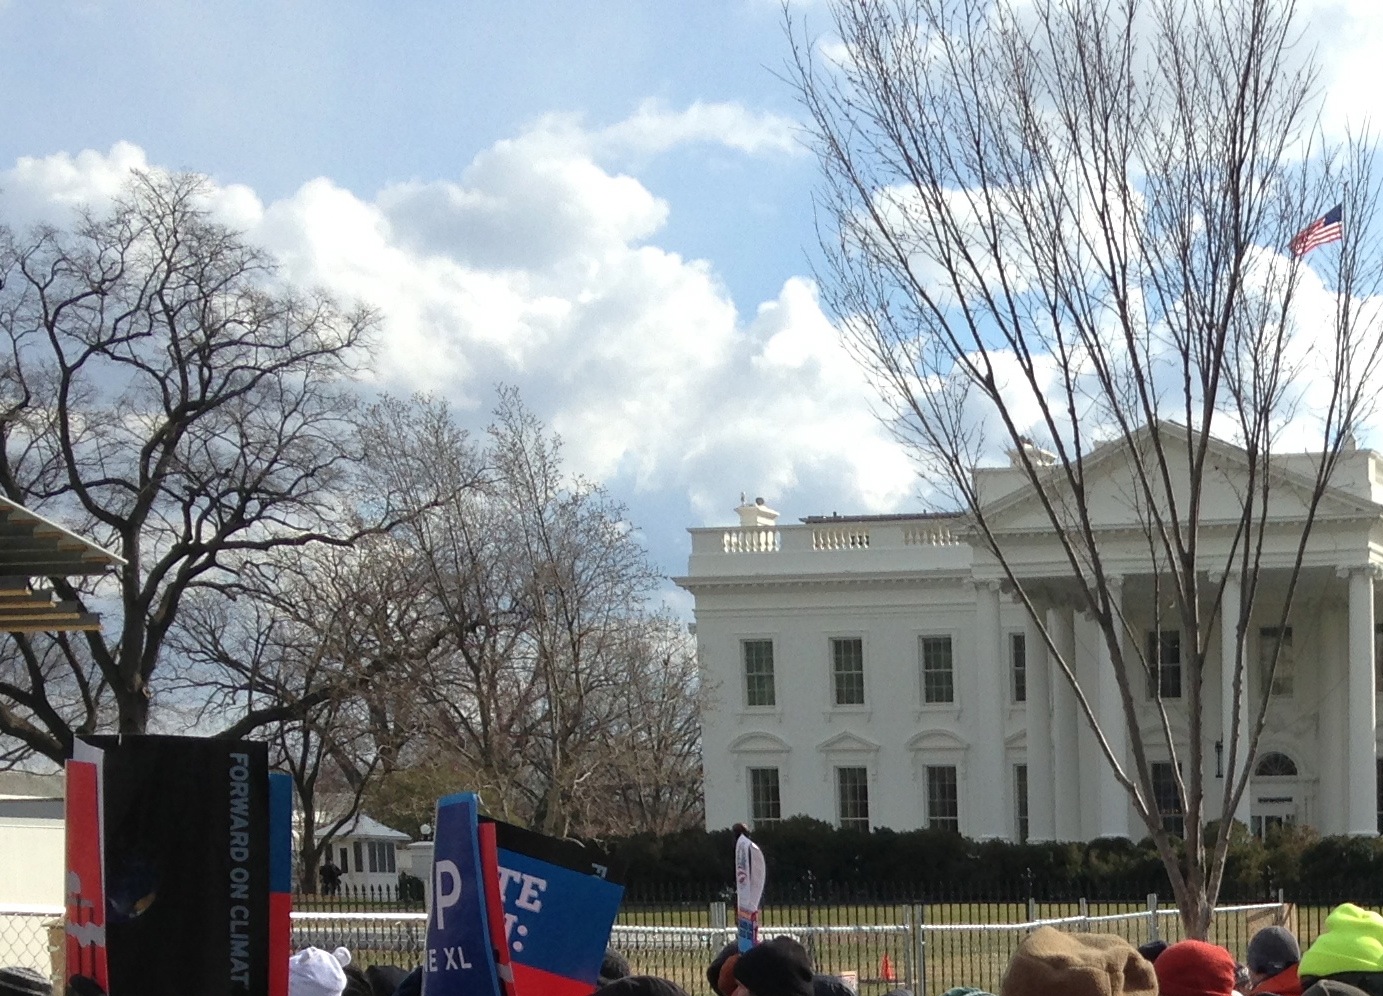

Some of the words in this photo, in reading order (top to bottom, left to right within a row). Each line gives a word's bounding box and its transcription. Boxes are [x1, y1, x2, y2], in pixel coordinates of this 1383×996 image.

[229, 753, 250, 862] FORWARD
[229, 867, 250, 899] ON
[443, 946, 472, 971] XL
